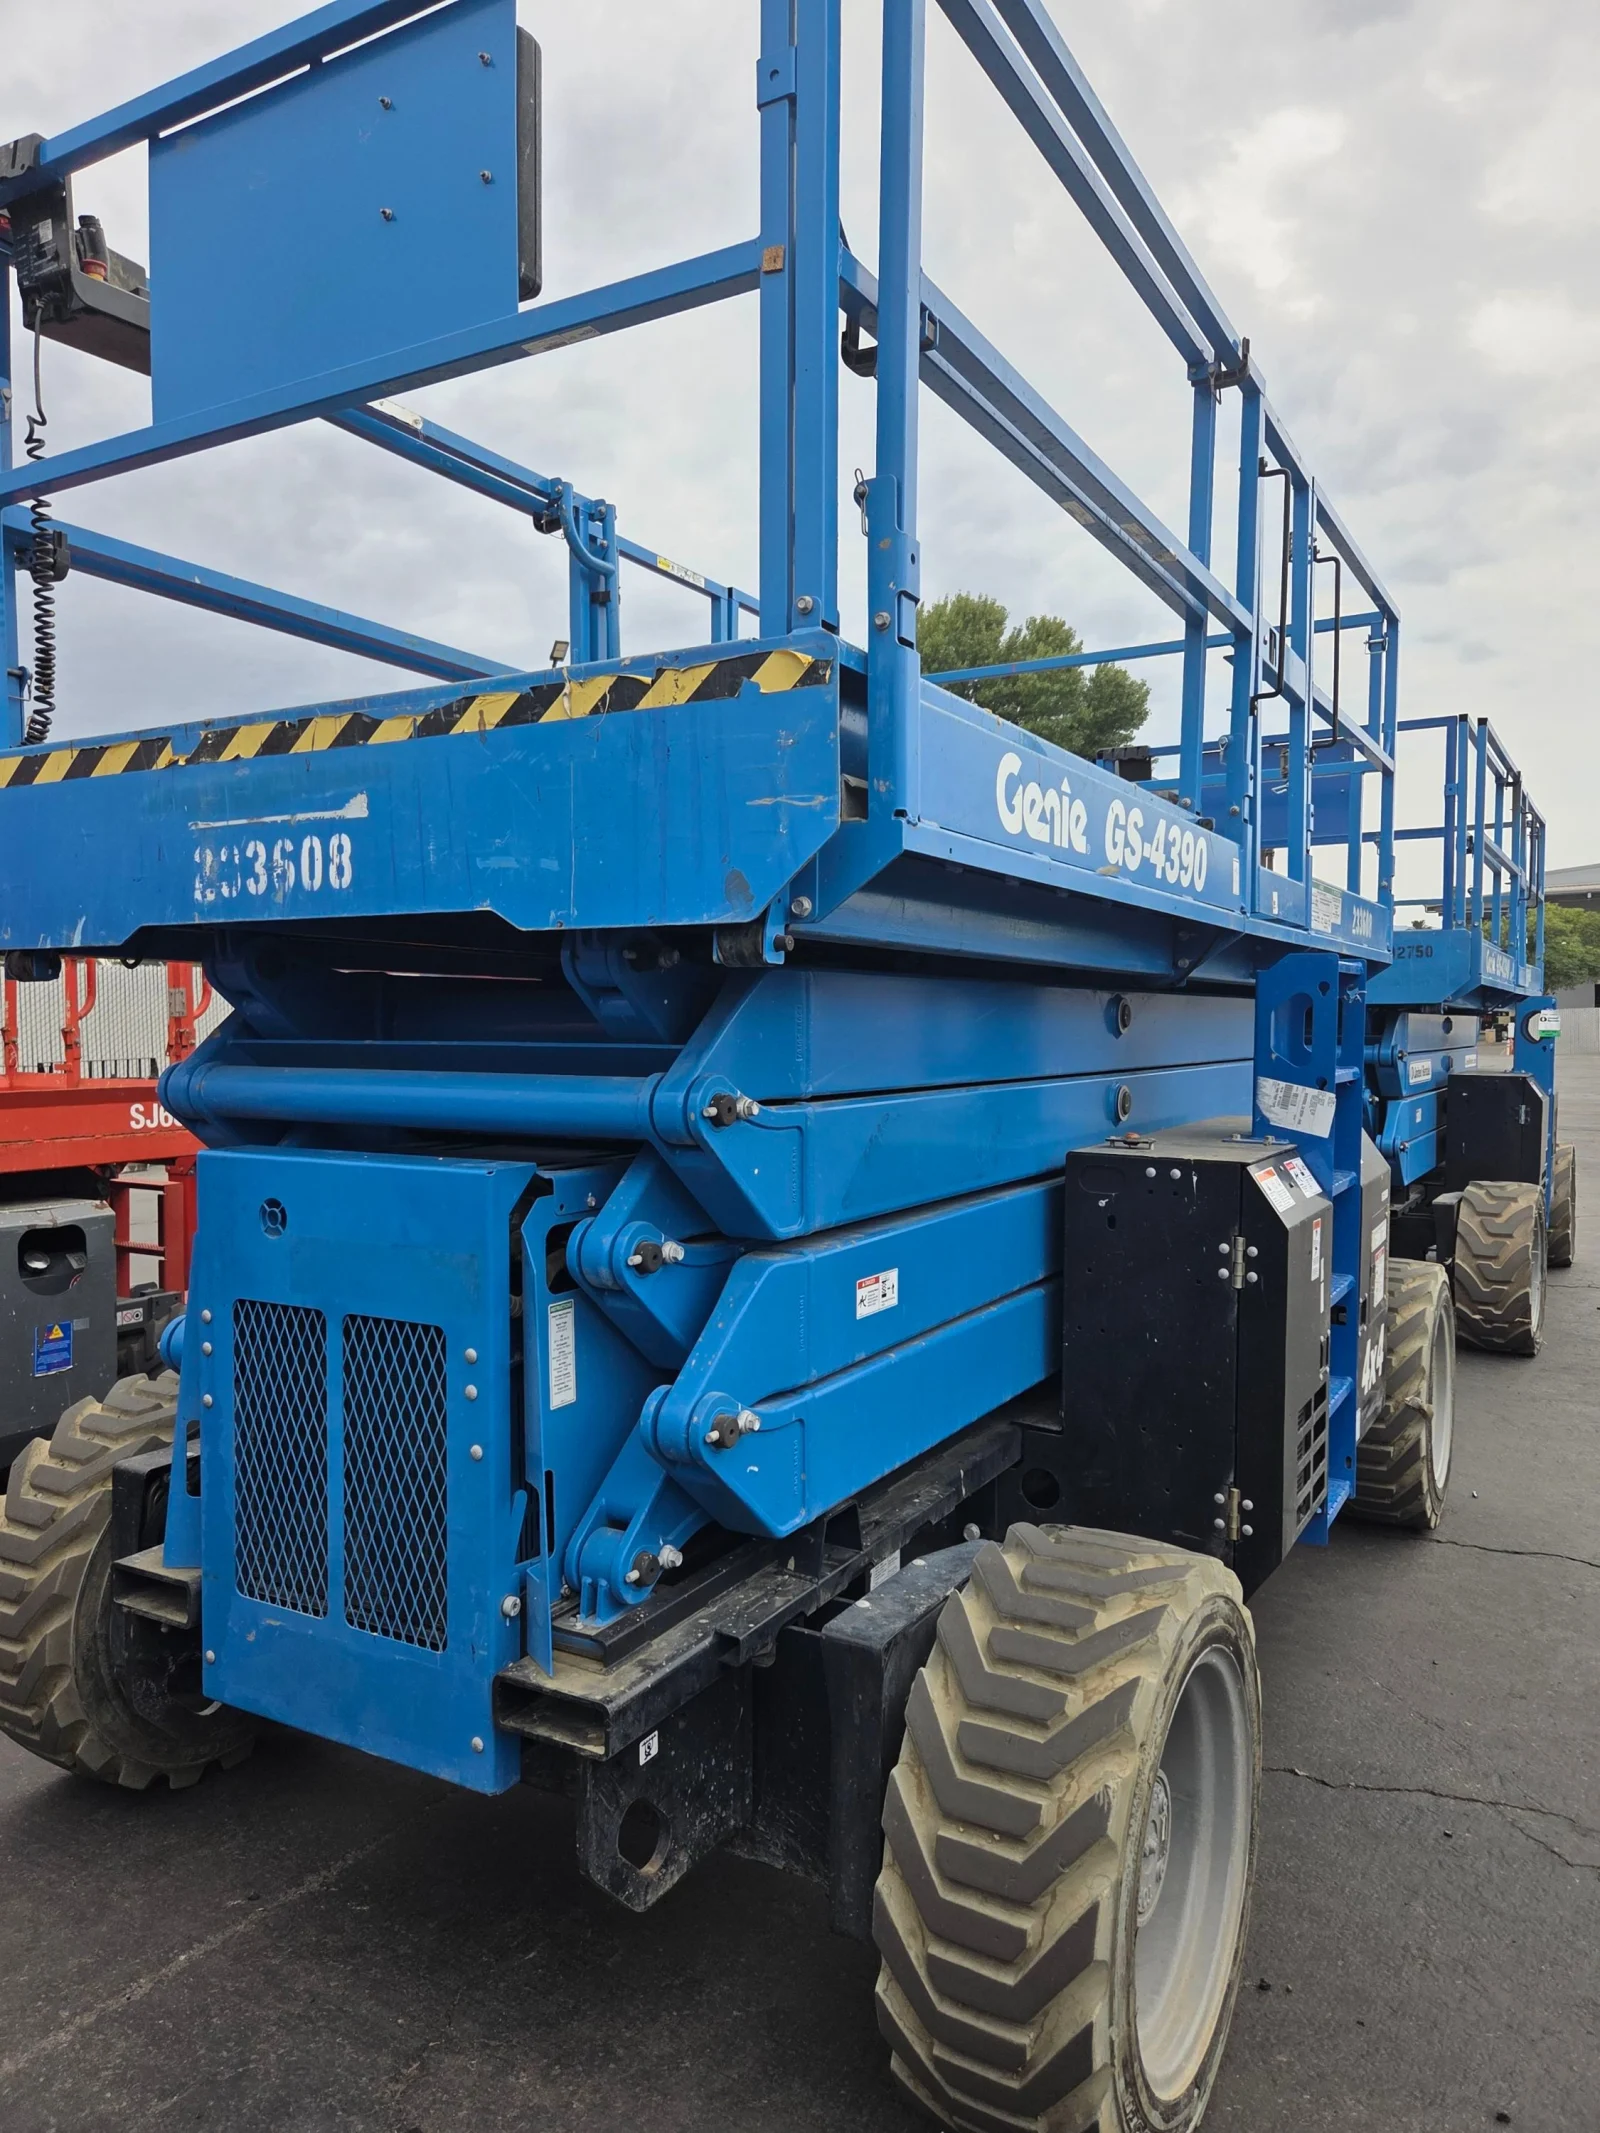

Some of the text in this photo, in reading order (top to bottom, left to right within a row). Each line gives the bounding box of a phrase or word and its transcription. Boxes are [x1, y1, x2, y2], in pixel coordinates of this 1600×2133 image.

[996, 752, 1208, 893] Genie GS-4390
[1393, 944, 1434, 960] 2750
[1361, 1323, 1385, 1396] 4x4
